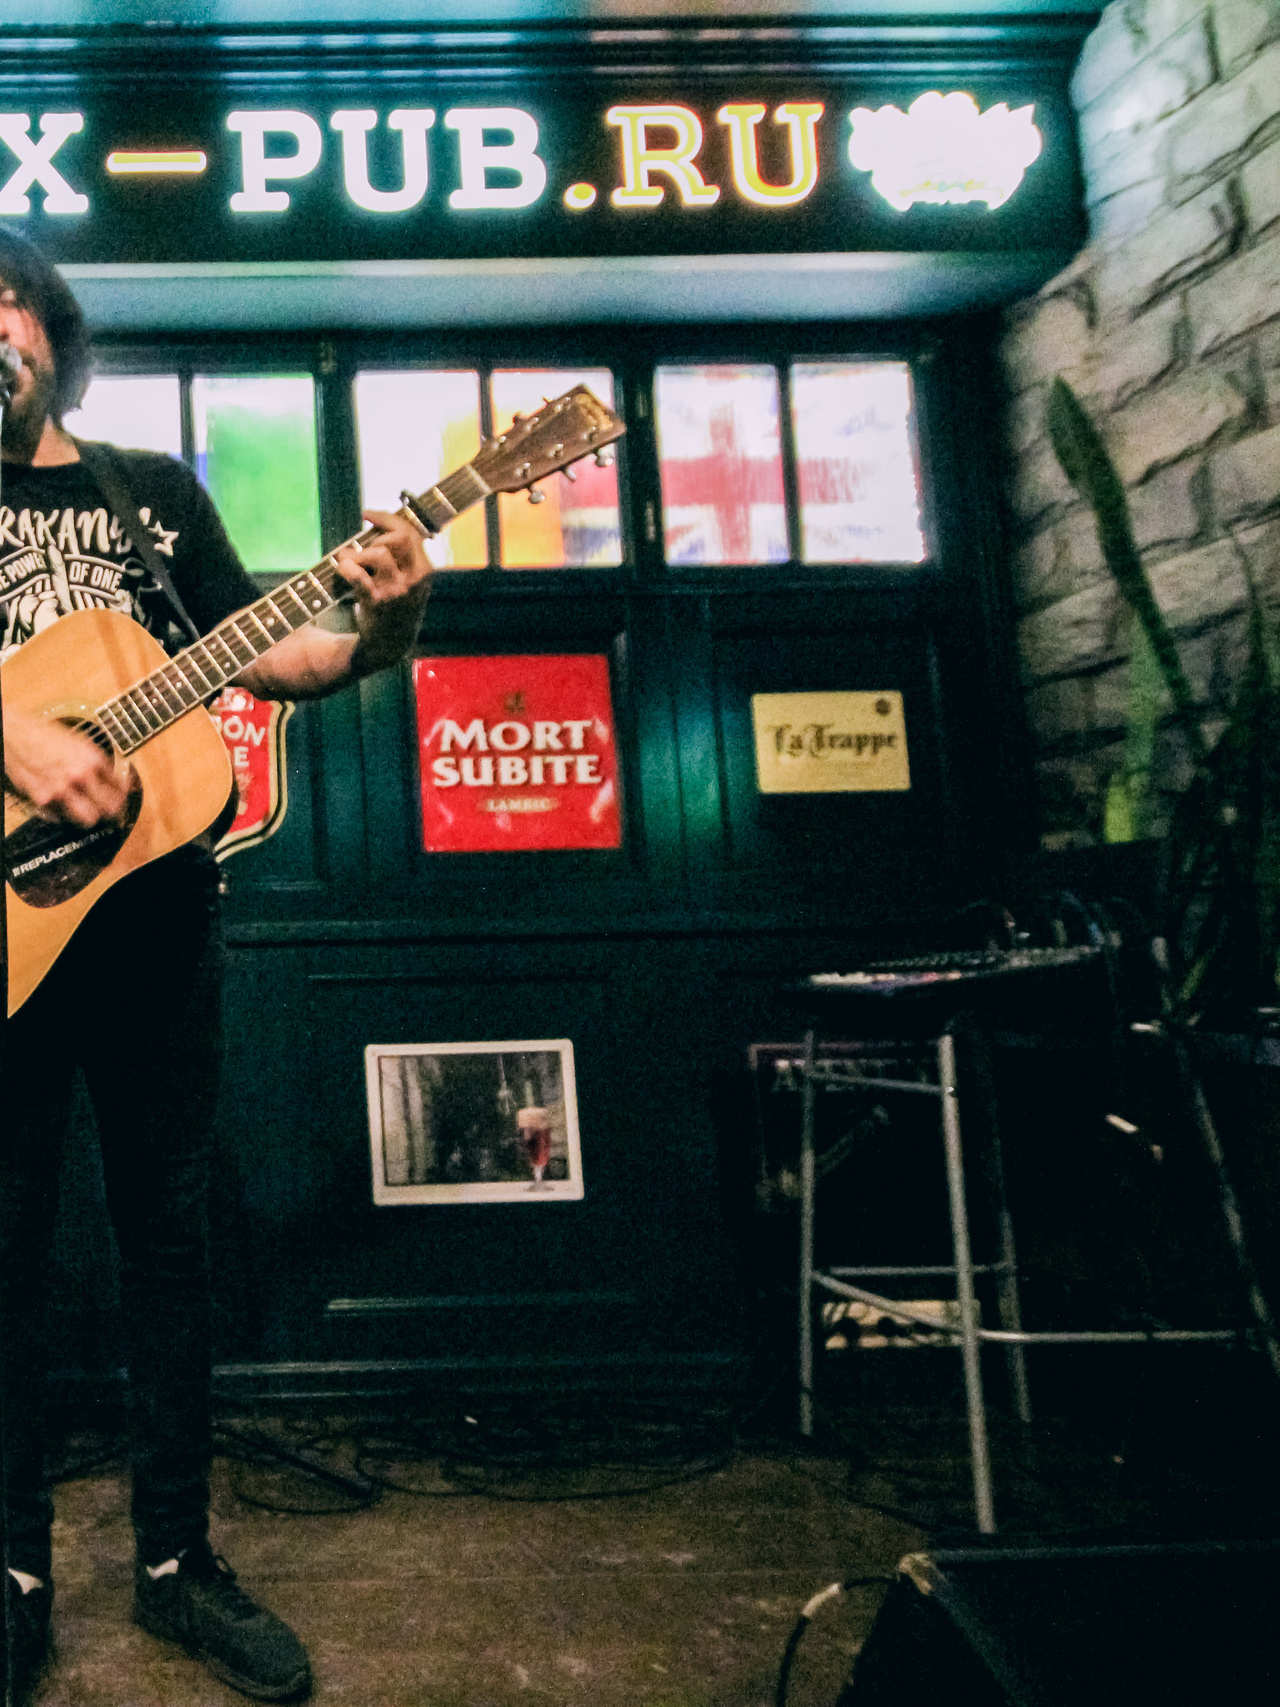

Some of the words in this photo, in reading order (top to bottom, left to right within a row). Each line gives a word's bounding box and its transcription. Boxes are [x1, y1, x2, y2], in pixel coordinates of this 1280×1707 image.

[4, 552, 47, 583] POWE
[70, 561, 89, 583] OF
[90, 566, 122, 592] ONE
[440, 719, 593, 752] MORT
[432, 754, 602, 788] SUBITE
